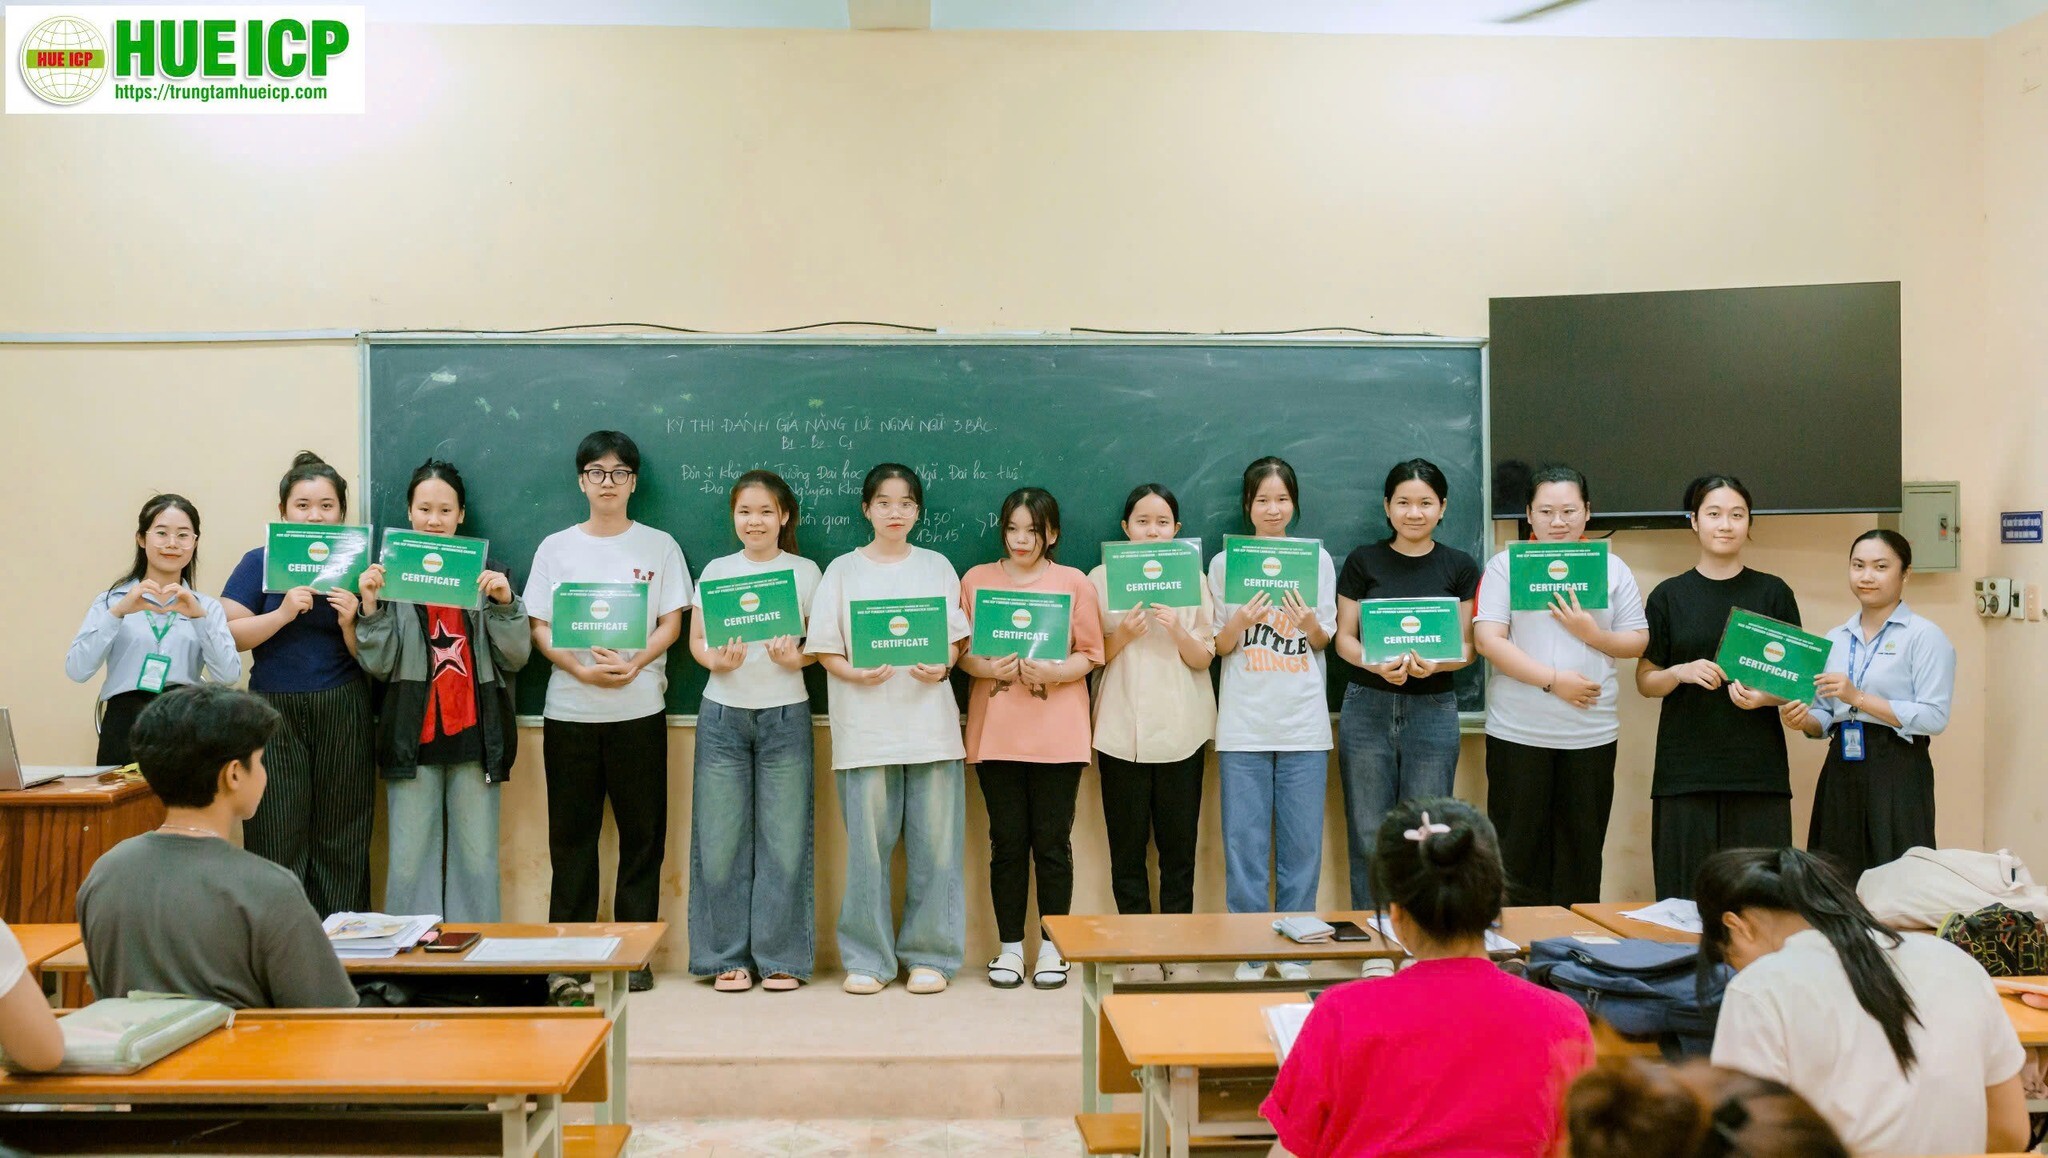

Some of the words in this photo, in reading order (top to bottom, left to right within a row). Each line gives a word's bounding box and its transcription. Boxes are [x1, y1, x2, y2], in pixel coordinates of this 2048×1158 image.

[288, 562, 349, 574] CERTIFITE
[401, 572, 461, 587] CERTIFICATE
[1243, 578, 1300, 589] CERTIFICATE
[1126, 581, 1183, 592] CERTIFICATE
[1529, 582, 1588, 592] CERTIFICATE
[723, 611, 781, 627] CERTIFICATE
[571, 621, 628, 631] CERTIFICATE
[992, 629, 1050, 641] CERTIFICATE
[1243, 622, 1308, 656] LITTLE
[1384, 635, 1442, 644] CERTIFICATE
[871, 638, 929, 649] CERTIFICATE
[1244, 647, 1311, 673] THINGS
[1738, 655, 1800, 682] CERTIFICATE
